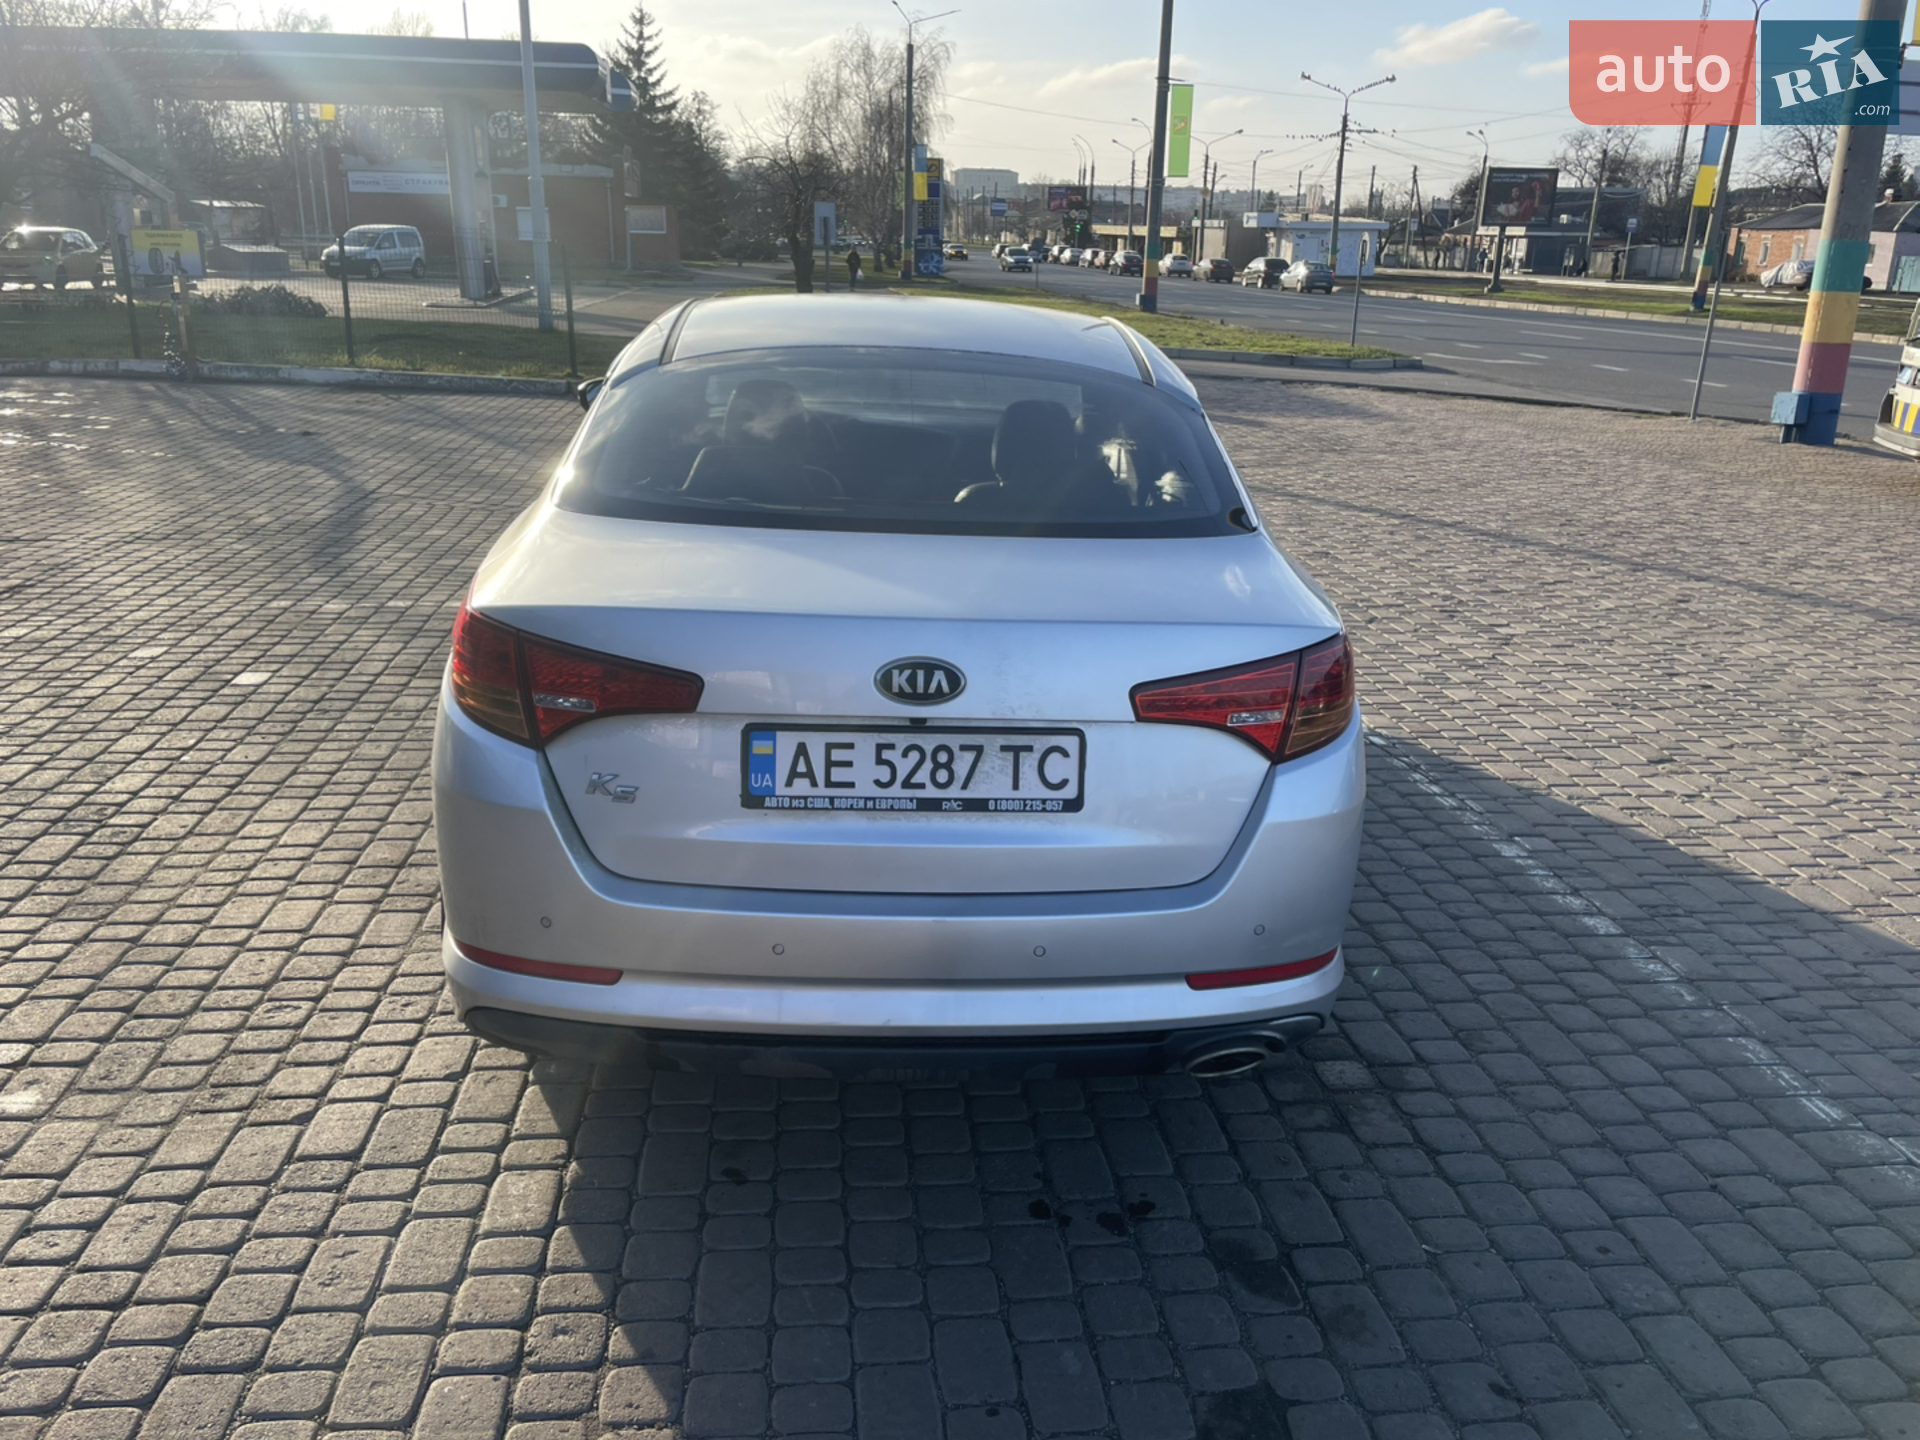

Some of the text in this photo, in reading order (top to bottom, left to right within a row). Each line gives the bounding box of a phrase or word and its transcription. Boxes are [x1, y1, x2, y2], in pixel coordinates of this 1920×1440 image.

[891, 668, 951, 694] KIA
[784, 741, 1071, 792] AE 5287 TC
[585, 771, 639, 804] K5
[751, 773, 774, 788] UA
[764, 796, 790, 808] АВТО
[875, 798, 917, 810] ЕВРОПЫ
[997, 799, 1024, 811] (800)
[1025, 800, 1064, 811] 215-057
